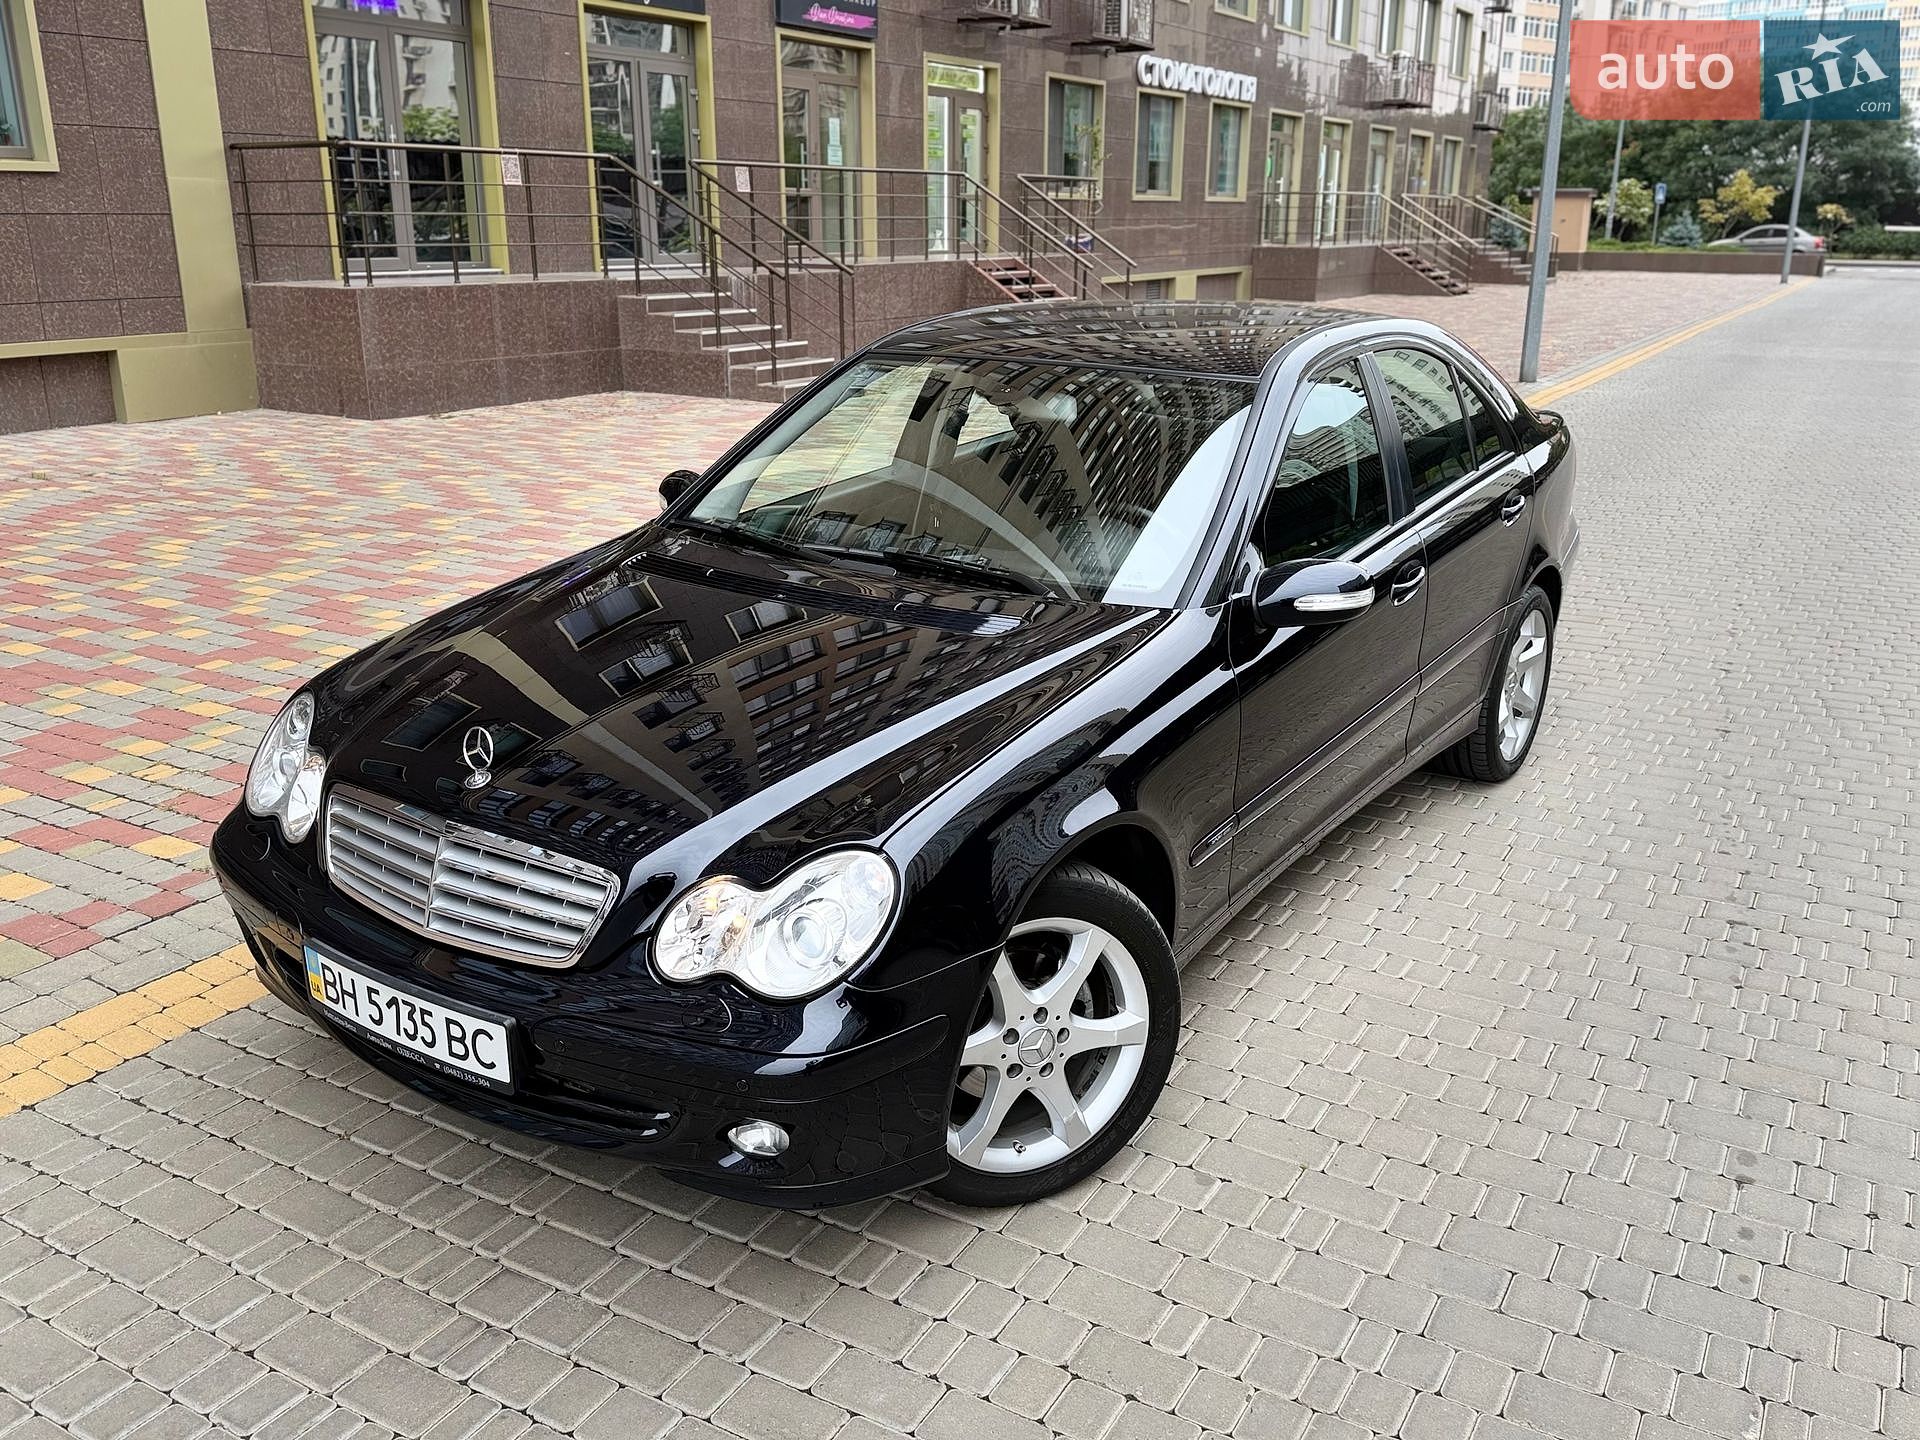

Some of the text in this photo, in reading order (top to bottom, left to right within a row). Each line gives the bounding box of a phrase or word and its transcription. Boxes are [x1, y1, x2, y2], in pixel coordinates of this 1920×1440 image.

[311, 980, 322, 995] UA
[321, 963, 496, 1070] BH 5135 BC
[464, 1073, 490, 1088] 355-304
